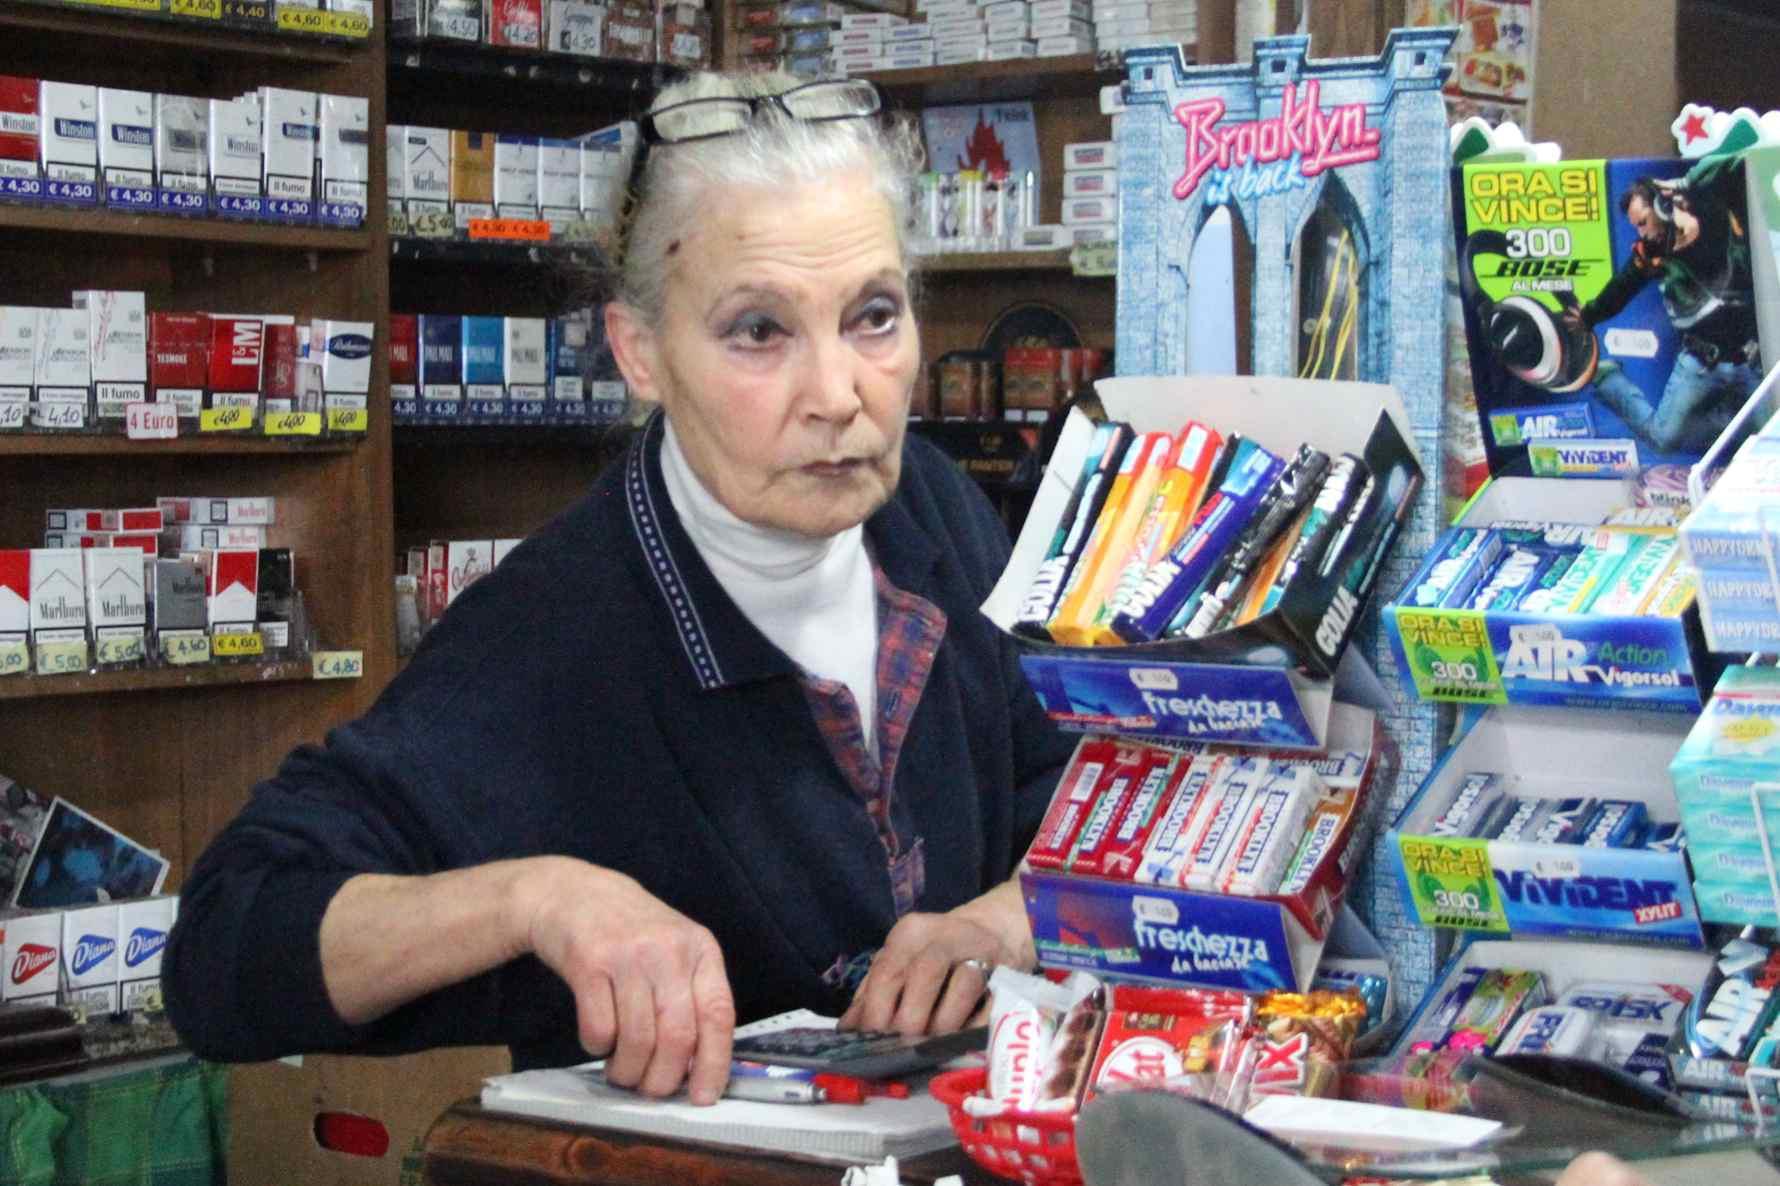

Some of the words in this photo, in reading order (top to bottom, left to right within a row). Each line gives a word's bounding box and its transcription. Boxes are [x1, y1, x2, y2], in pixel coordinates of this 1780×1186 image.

[60, 120, 95, 138] Winston
[117, 125, 151, 144] Winston
[1173, 79, 1381, 199] Brooklyn
[1239, 152, 1306, 200] back
[1471, 171, 1554, 198] ORA
[1559, 168, 1598, 195] SI
[8, 181, 39, 194] 4,30
[50, 184, 58, 194] €
[61, 185, 92, 198] 4,30
[111, 190, 119, 200] €
[122, 190, 152, 203] 4,30
[161, 194, 169, 204] €
[173, 194, 202, 208] 4,30
[220, 199, 228, 209] €
[232, 199, 260, 211] 4,30
[280, 203, 308, 215] 4,30
[1471, 195, 1601, 225] VINCE!
[332, 207, 359, 219] 4,30
[1505, 228, 1572, 258] 300
[102, 388, 109, 399] Il
[112, 388, 141, 399] fumo
[130, 412, 138, 429] 4
[143, 412, 175, 430] Euro
[1521, 414, 1558, 438] AIR
[1315, 585, 1359, 656] GOLIA
[1400, 614, 1453, 631] ORA
[1501, 636, 1592, 683] AIR
[1600, 641, 1671, 666] Action
[1431, 660, 1477, 680] 300
[1598, 665, 1680, 688] Vigorsol
[1403, 841, 1457, 861] ORA
[1433, 889, 1479, 910] 300
[1635, 901, 1678, 925] XYLIT
[74, 937, 117, 968] Diana
[127, 929, 169, 962] Diana
[14, 947, 56, 975] Diana
[1696, 976, 1773, 1057] AIR
